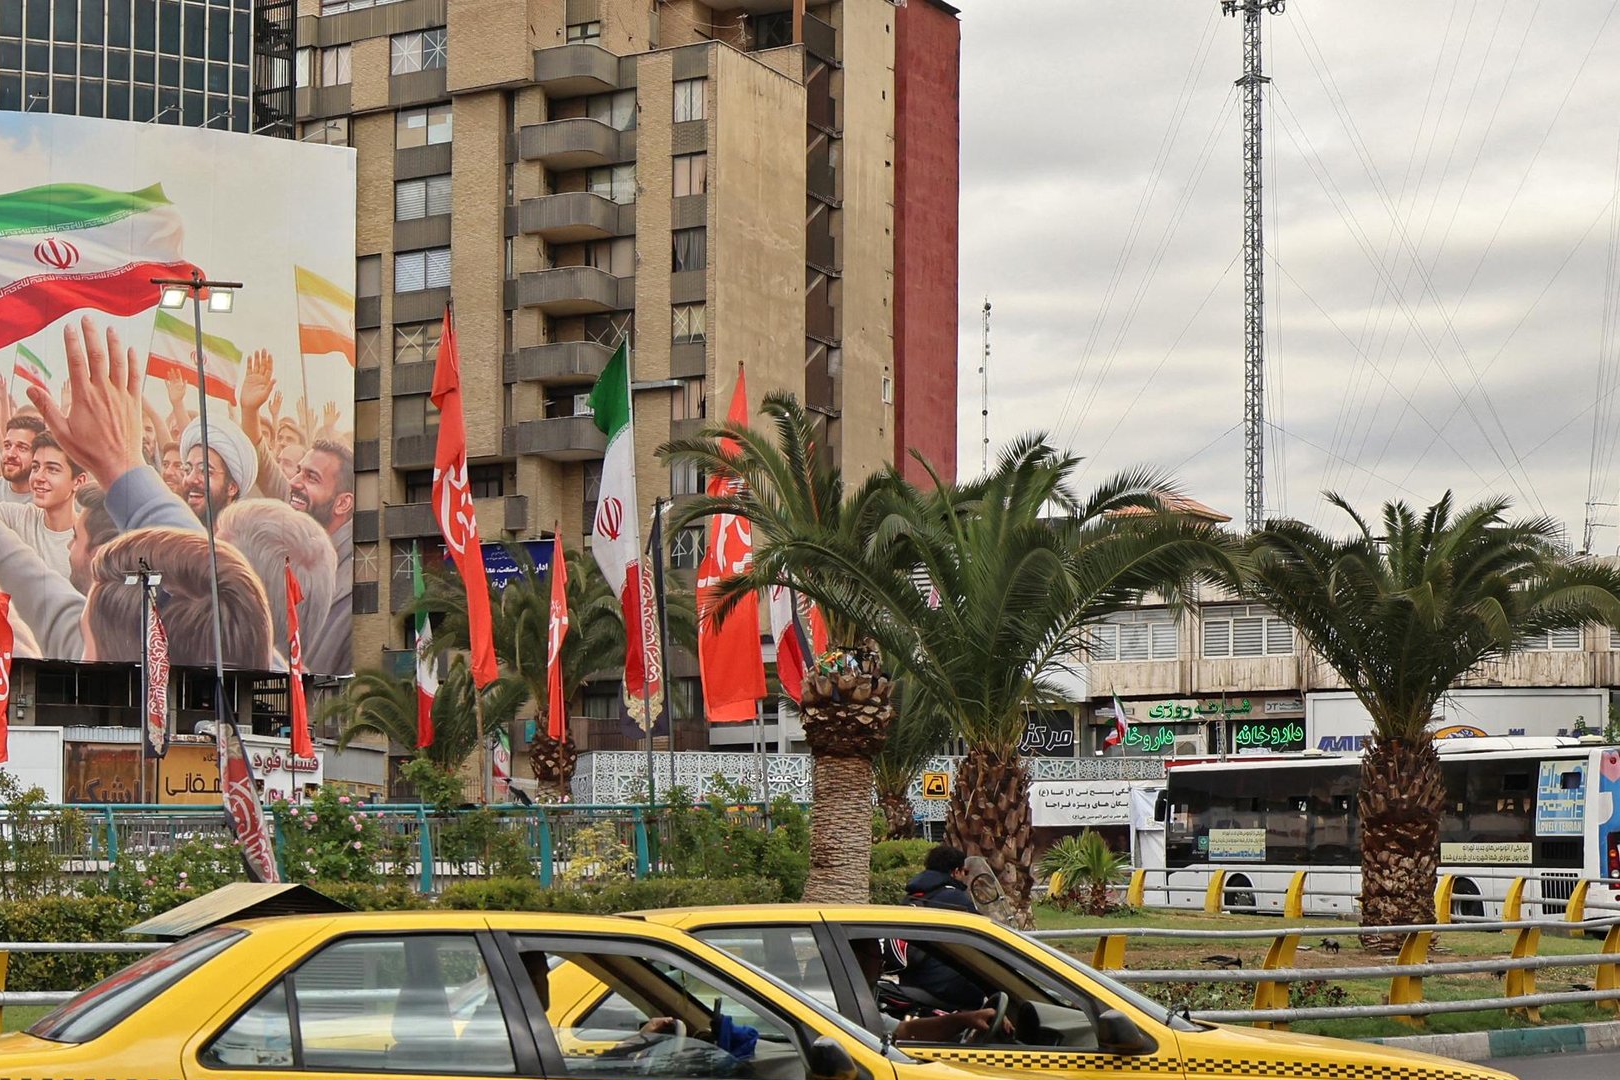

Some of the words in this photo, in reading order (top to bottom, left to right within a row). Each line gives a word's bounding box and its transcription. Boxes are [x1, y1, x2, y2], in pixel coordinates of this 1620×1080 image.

[1148, 701, 1193, 720] روزی
[1124, 725, 1175, 751] داروخا
[1236, 722, 1304, 745] داروخانه
[253, 747, 281, 774] فود
[1537, 820, 1558, 832] LOVELY
[1559, 820, 1582, 833] TEHRAN
